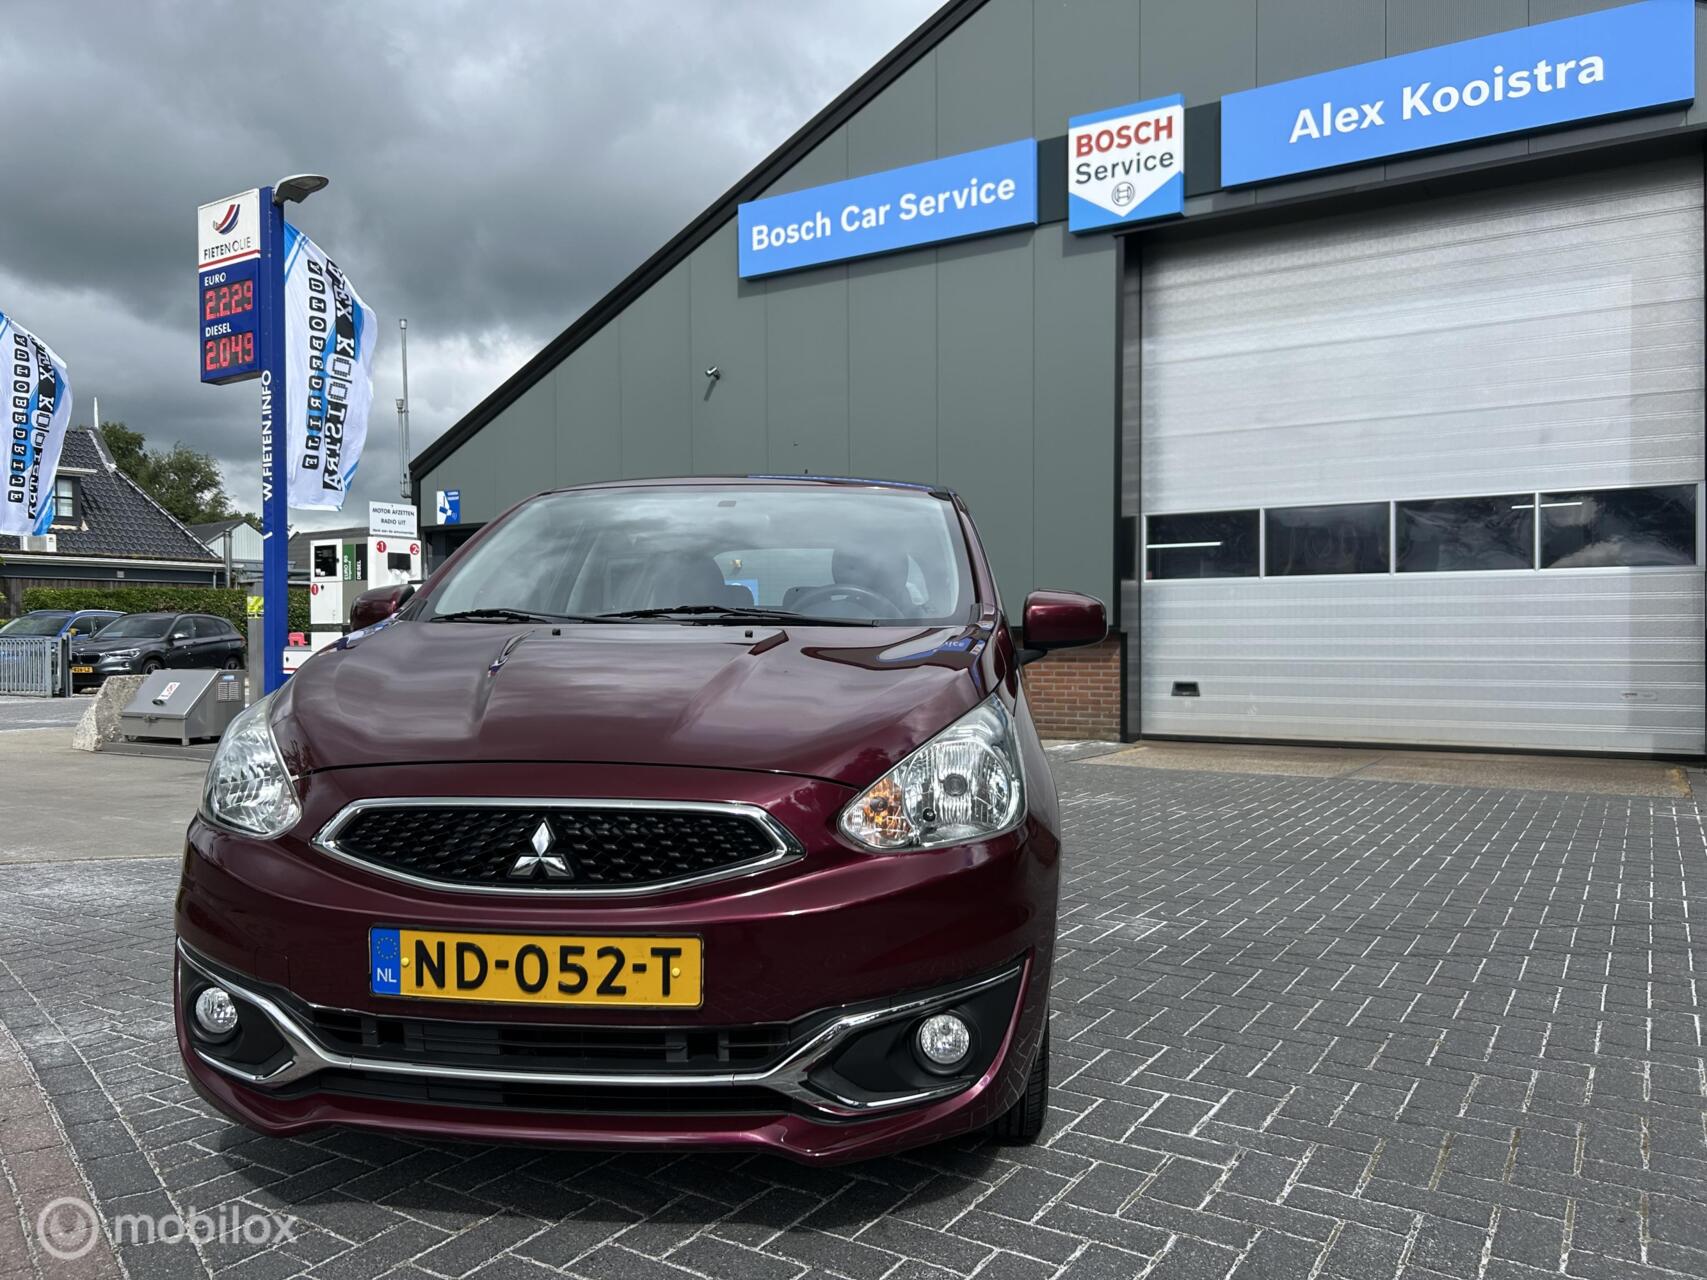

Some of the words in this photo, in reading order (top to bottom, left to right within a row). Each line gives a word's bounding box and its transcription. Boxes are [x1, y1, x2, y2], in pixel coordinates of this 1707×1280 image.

[1289, 101, 1384, 144] Alex
[1401, 55, 1604, 121] Kooistra
[1076, 116, 1173, 158] BOSCH
[1075, 152, 1174, 184] Service
[751, 211, 831, 251] Bosch
[840, 203, 890, 232] Car
[899, 178, 1016, 221] Service
[204, 272, 226, 286] EURO
[206, 280, 252, 320] 2.229
[205, 322, 231, 336] DIESEL
[206, 332, 253, 370] 2.049
[376, 967, 397, 983] NL
[414, 939, 682, 996] ND-052-T
